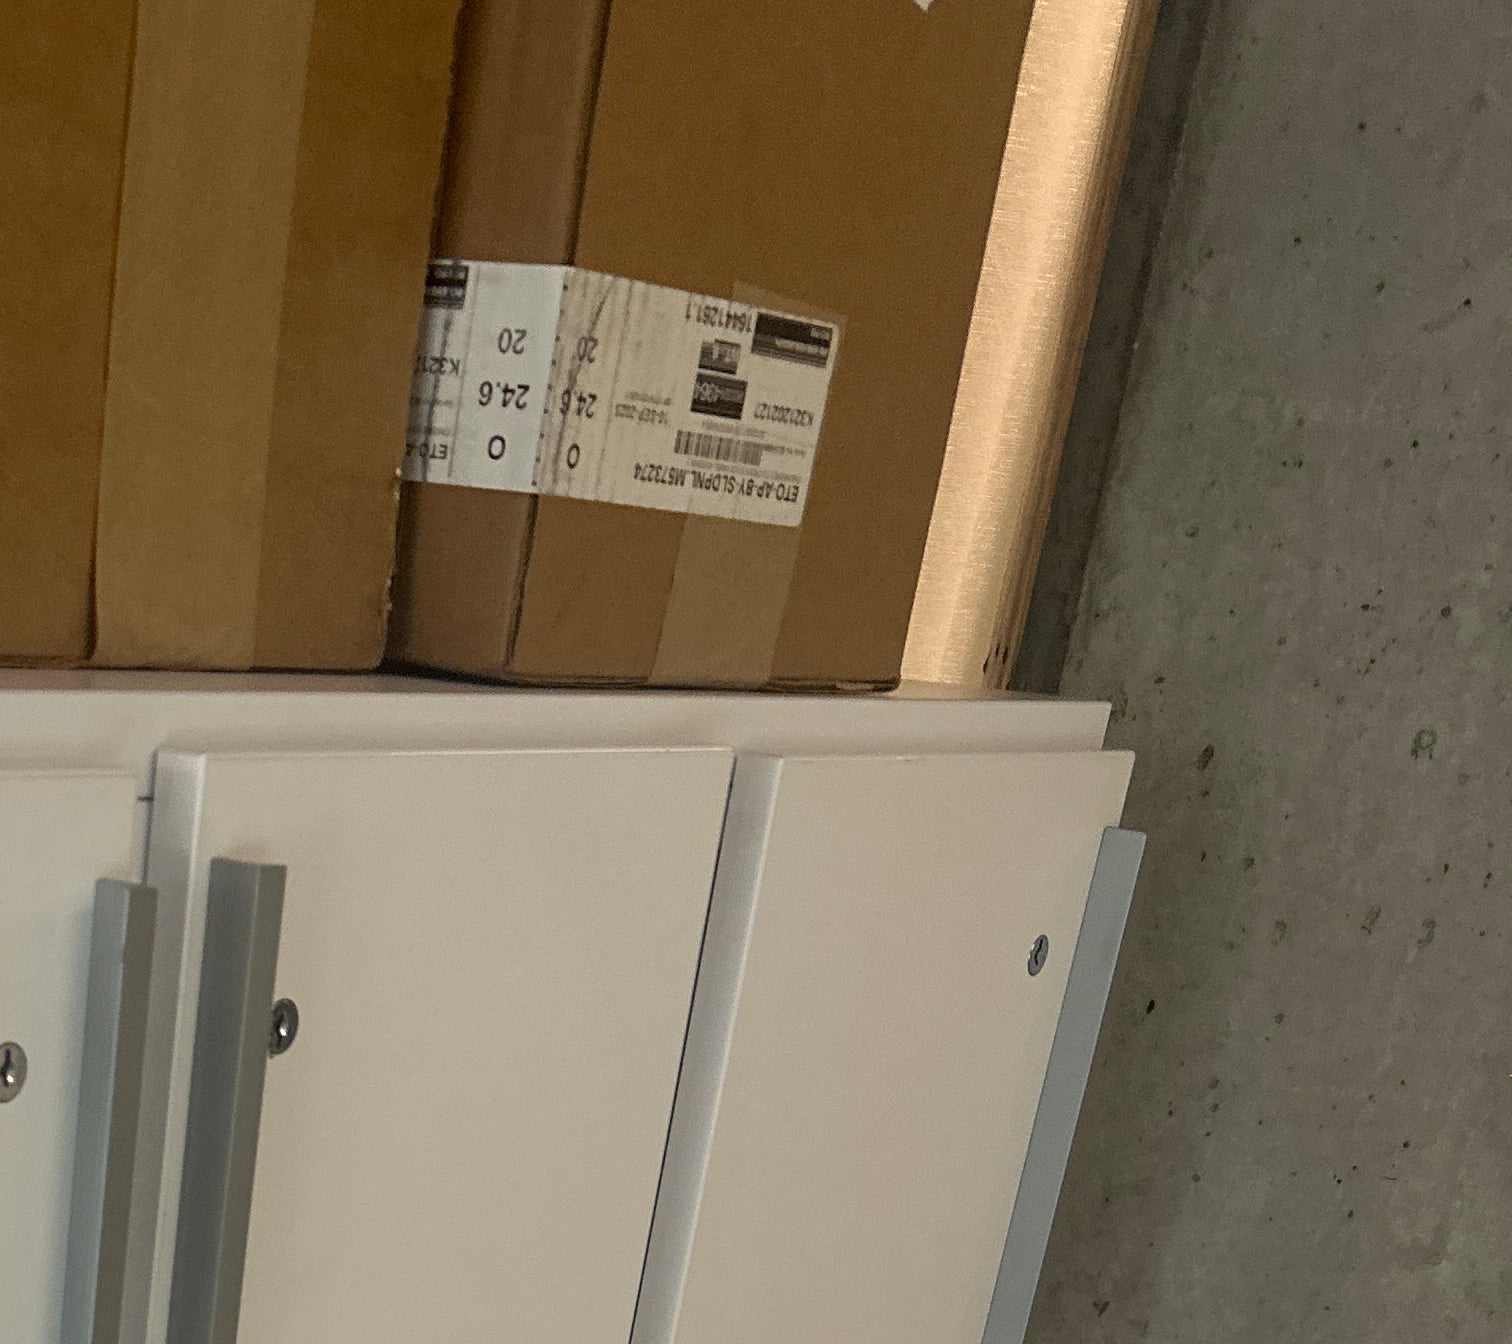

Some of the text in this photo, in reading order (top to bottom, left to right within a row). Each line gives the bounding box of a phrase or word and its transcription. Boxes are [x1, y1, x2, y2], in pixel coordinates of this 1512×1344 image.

[497, 328, 528, 355] 20
[577, 336, 599, 363] 20
[478, 381, 530, 409] 24.6
[560, 390, 598, 419] 24.6
